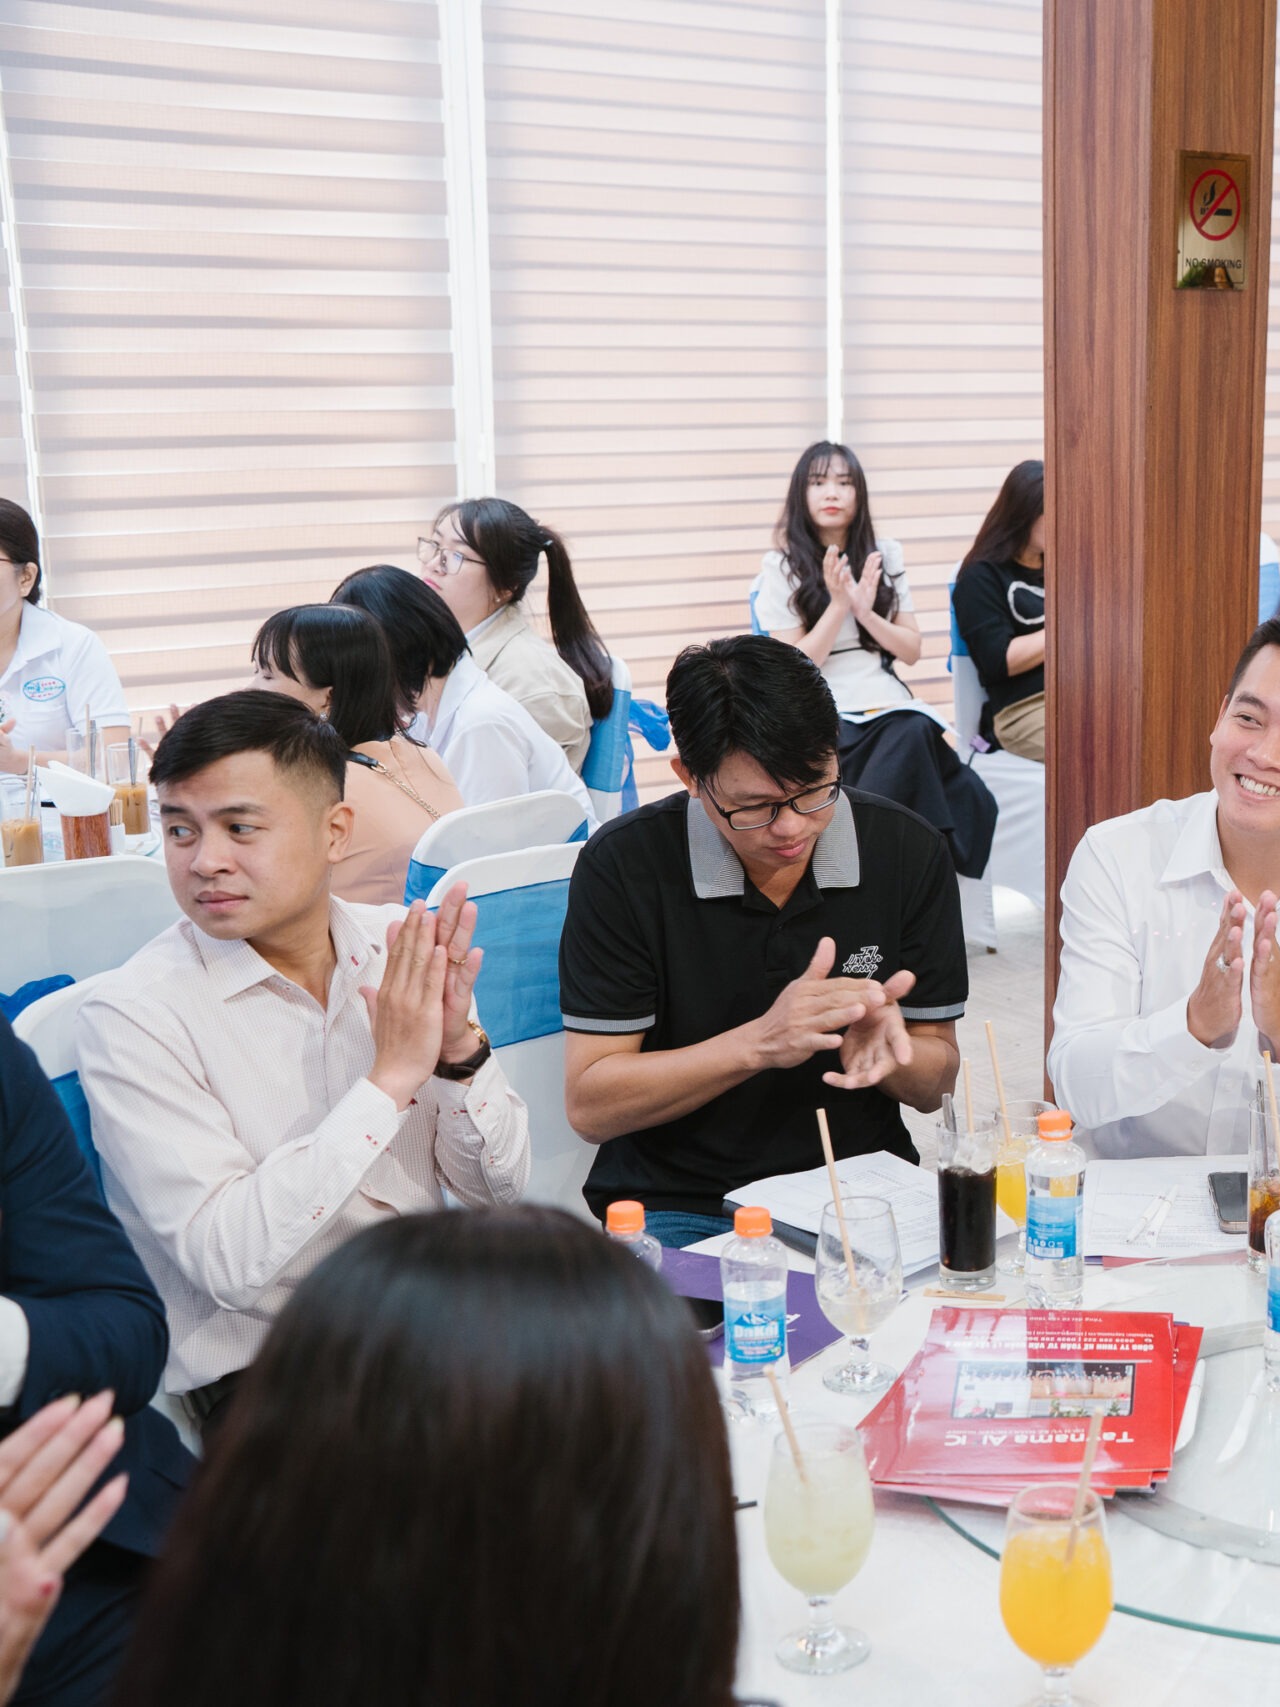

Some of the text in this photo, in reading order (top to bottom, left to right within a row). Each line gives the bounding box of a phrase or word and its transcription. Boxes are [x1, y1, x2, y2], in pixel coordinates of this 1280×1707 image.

[1185, 257, 1242, 269] NO SMOKING
[1119, 1343, 1130, 1351] TY
[1014, 1430, 1135, 1445] Tanama
